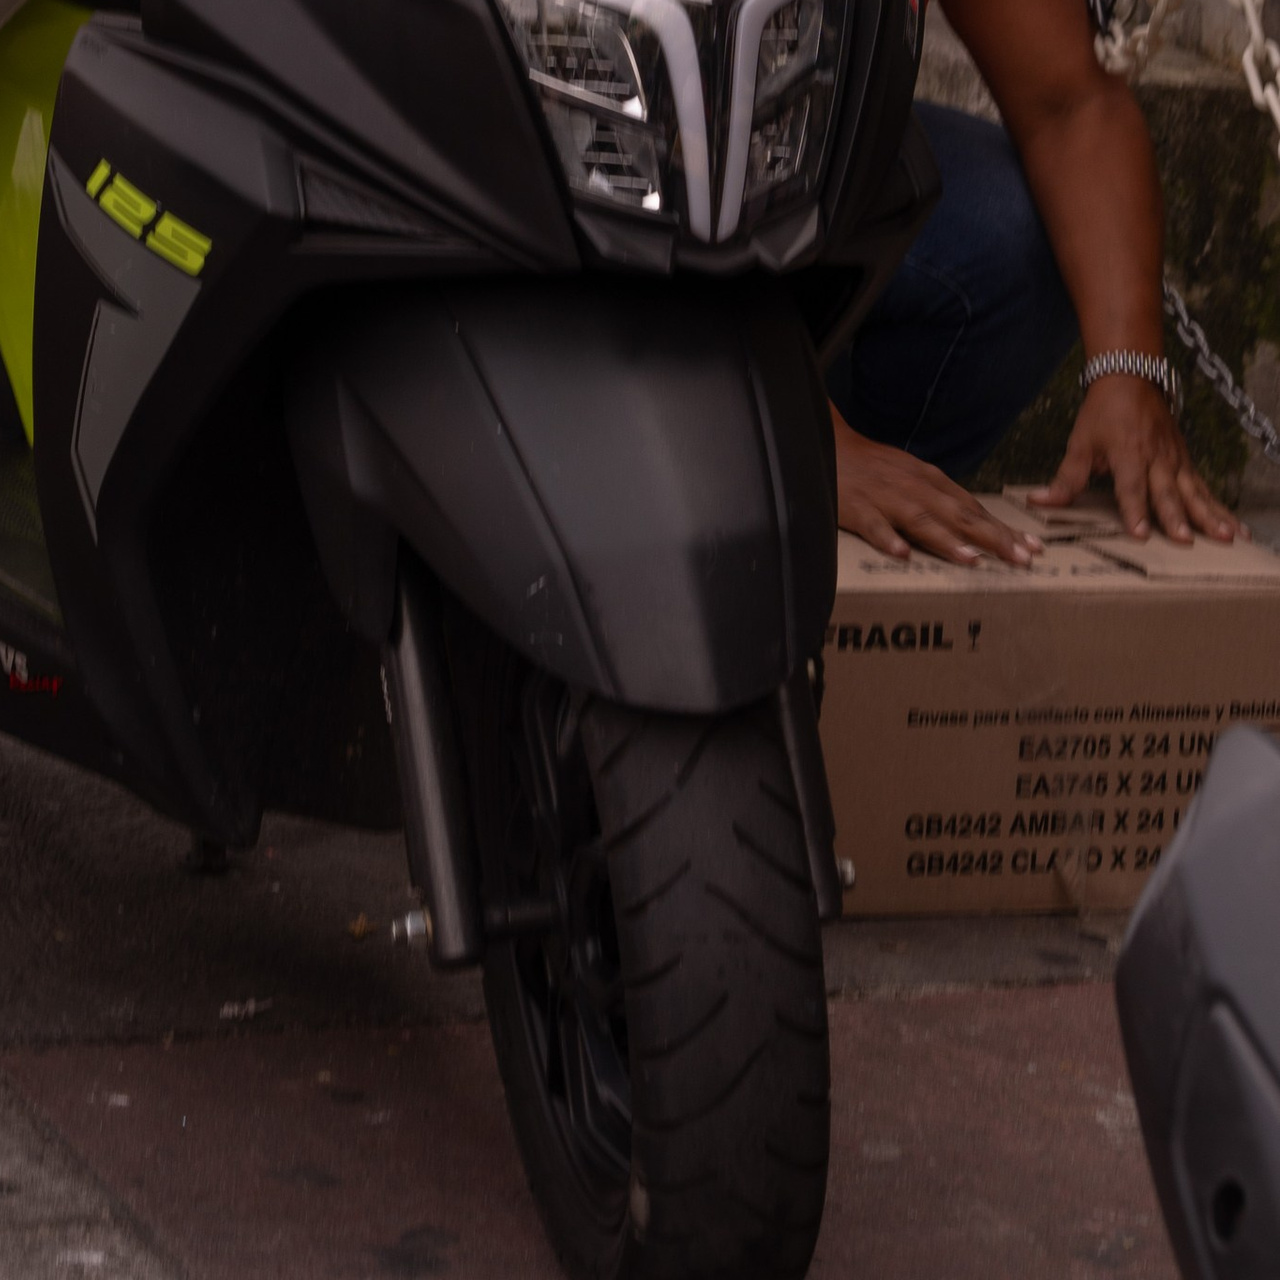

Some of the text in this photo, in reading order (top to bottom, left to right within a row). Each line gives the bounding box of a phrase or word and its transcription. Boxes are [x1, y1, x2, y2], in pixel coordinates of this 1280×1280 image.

[86, 157, 212, 278] 125
[907, 707, 969, 729] Envase
[972, 708, 1010, 731] para
[1093, 706, 1124, 724] con
[1129, 700, 1210, 723] Alimentos
[1215, 703, 1225, 724] y
[1119, 733, 1135, 759] X
[1142, 732, 1169, 758] 24
[1116, 770, 1133, 796] X
[1139, 770, 1167, 796] 24
[904, 812, 1002, 840] GB4242
[1112, 807, 1129, 835] X
[1135, 807, 1164, 834] 24
[906, 850, 1004, 878] GB4242
[1109, 846, 1126, 872] X
[1133, 845, 1162, 871] 24
